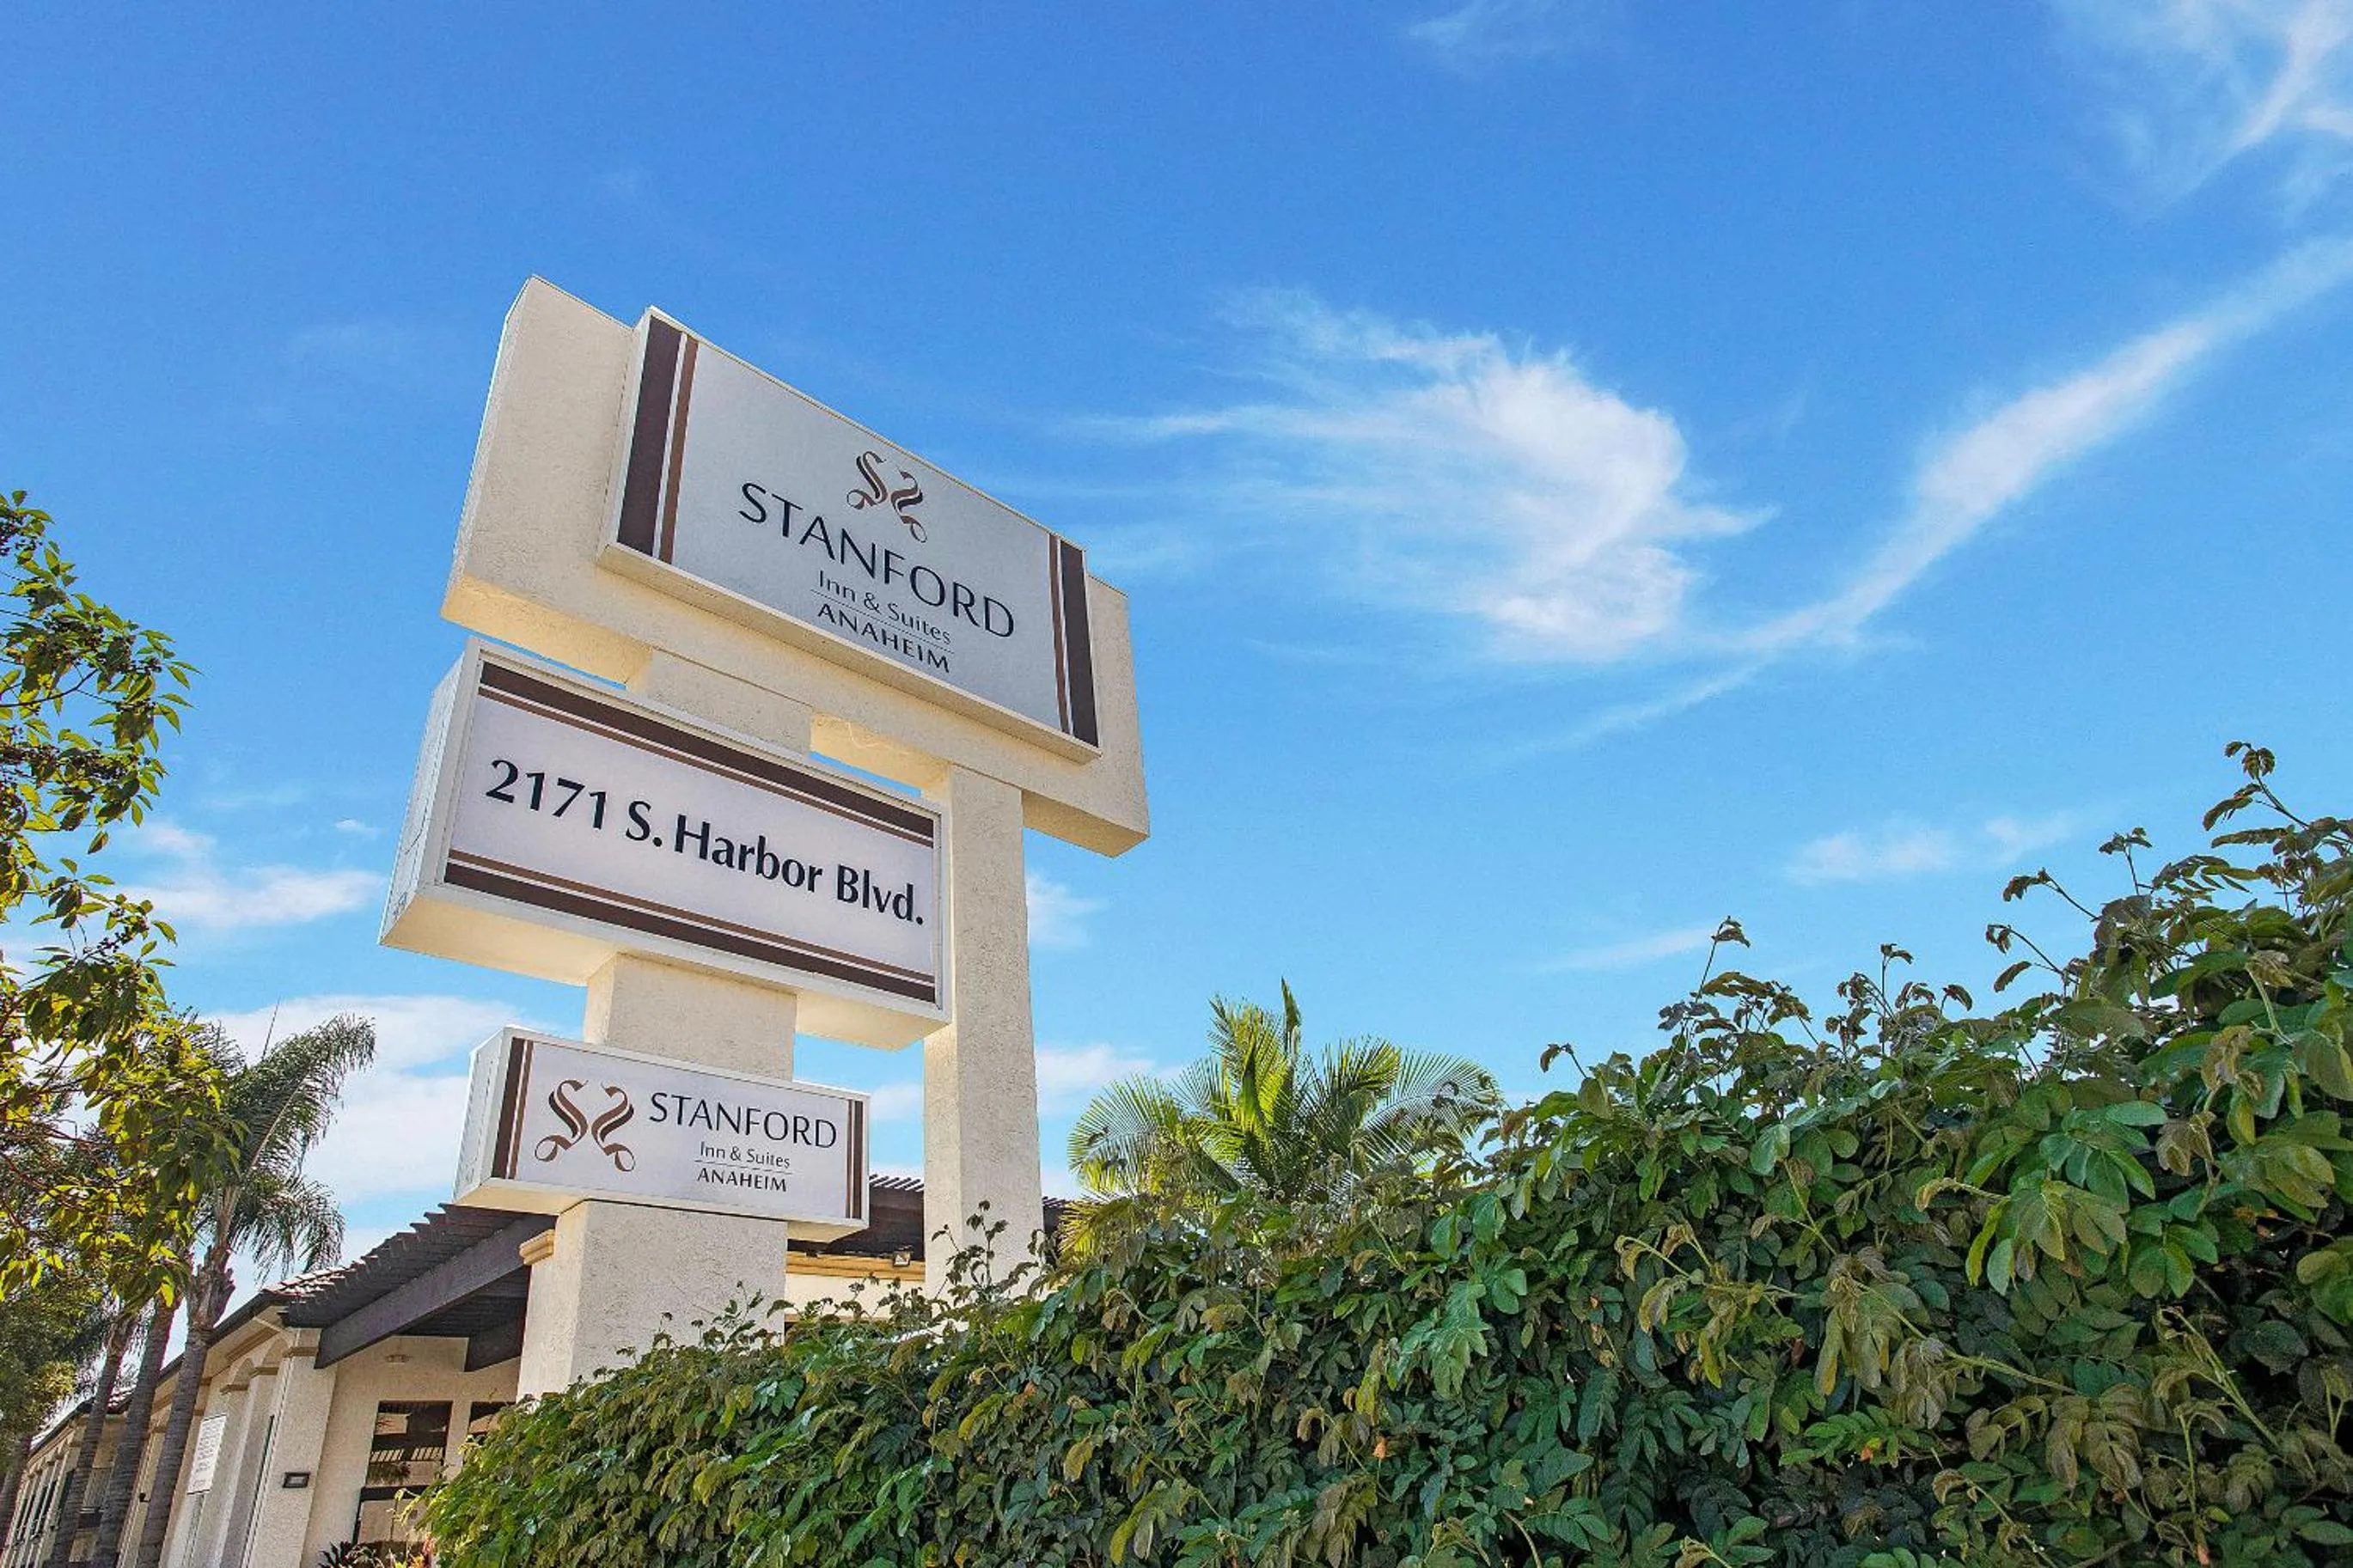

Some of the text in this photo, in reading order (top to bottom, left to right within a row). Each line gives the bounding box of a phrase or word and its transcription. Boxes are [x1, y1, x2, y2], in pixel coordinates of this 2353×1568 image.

[738, 482, 1015, 638] STANFORD
[817, 603, 950, 674] ANAHEIM
[820, 570, 951, 645] Inn & Suites
[486, 759, 925, 925] 2171 S. Harbor Blvd.
[649, 1092, 837, 1149] STANFORD
[700, 1141, 791, 1169] Inn & Suites
[697, 1168, 787, 1193] ANAHEIM
